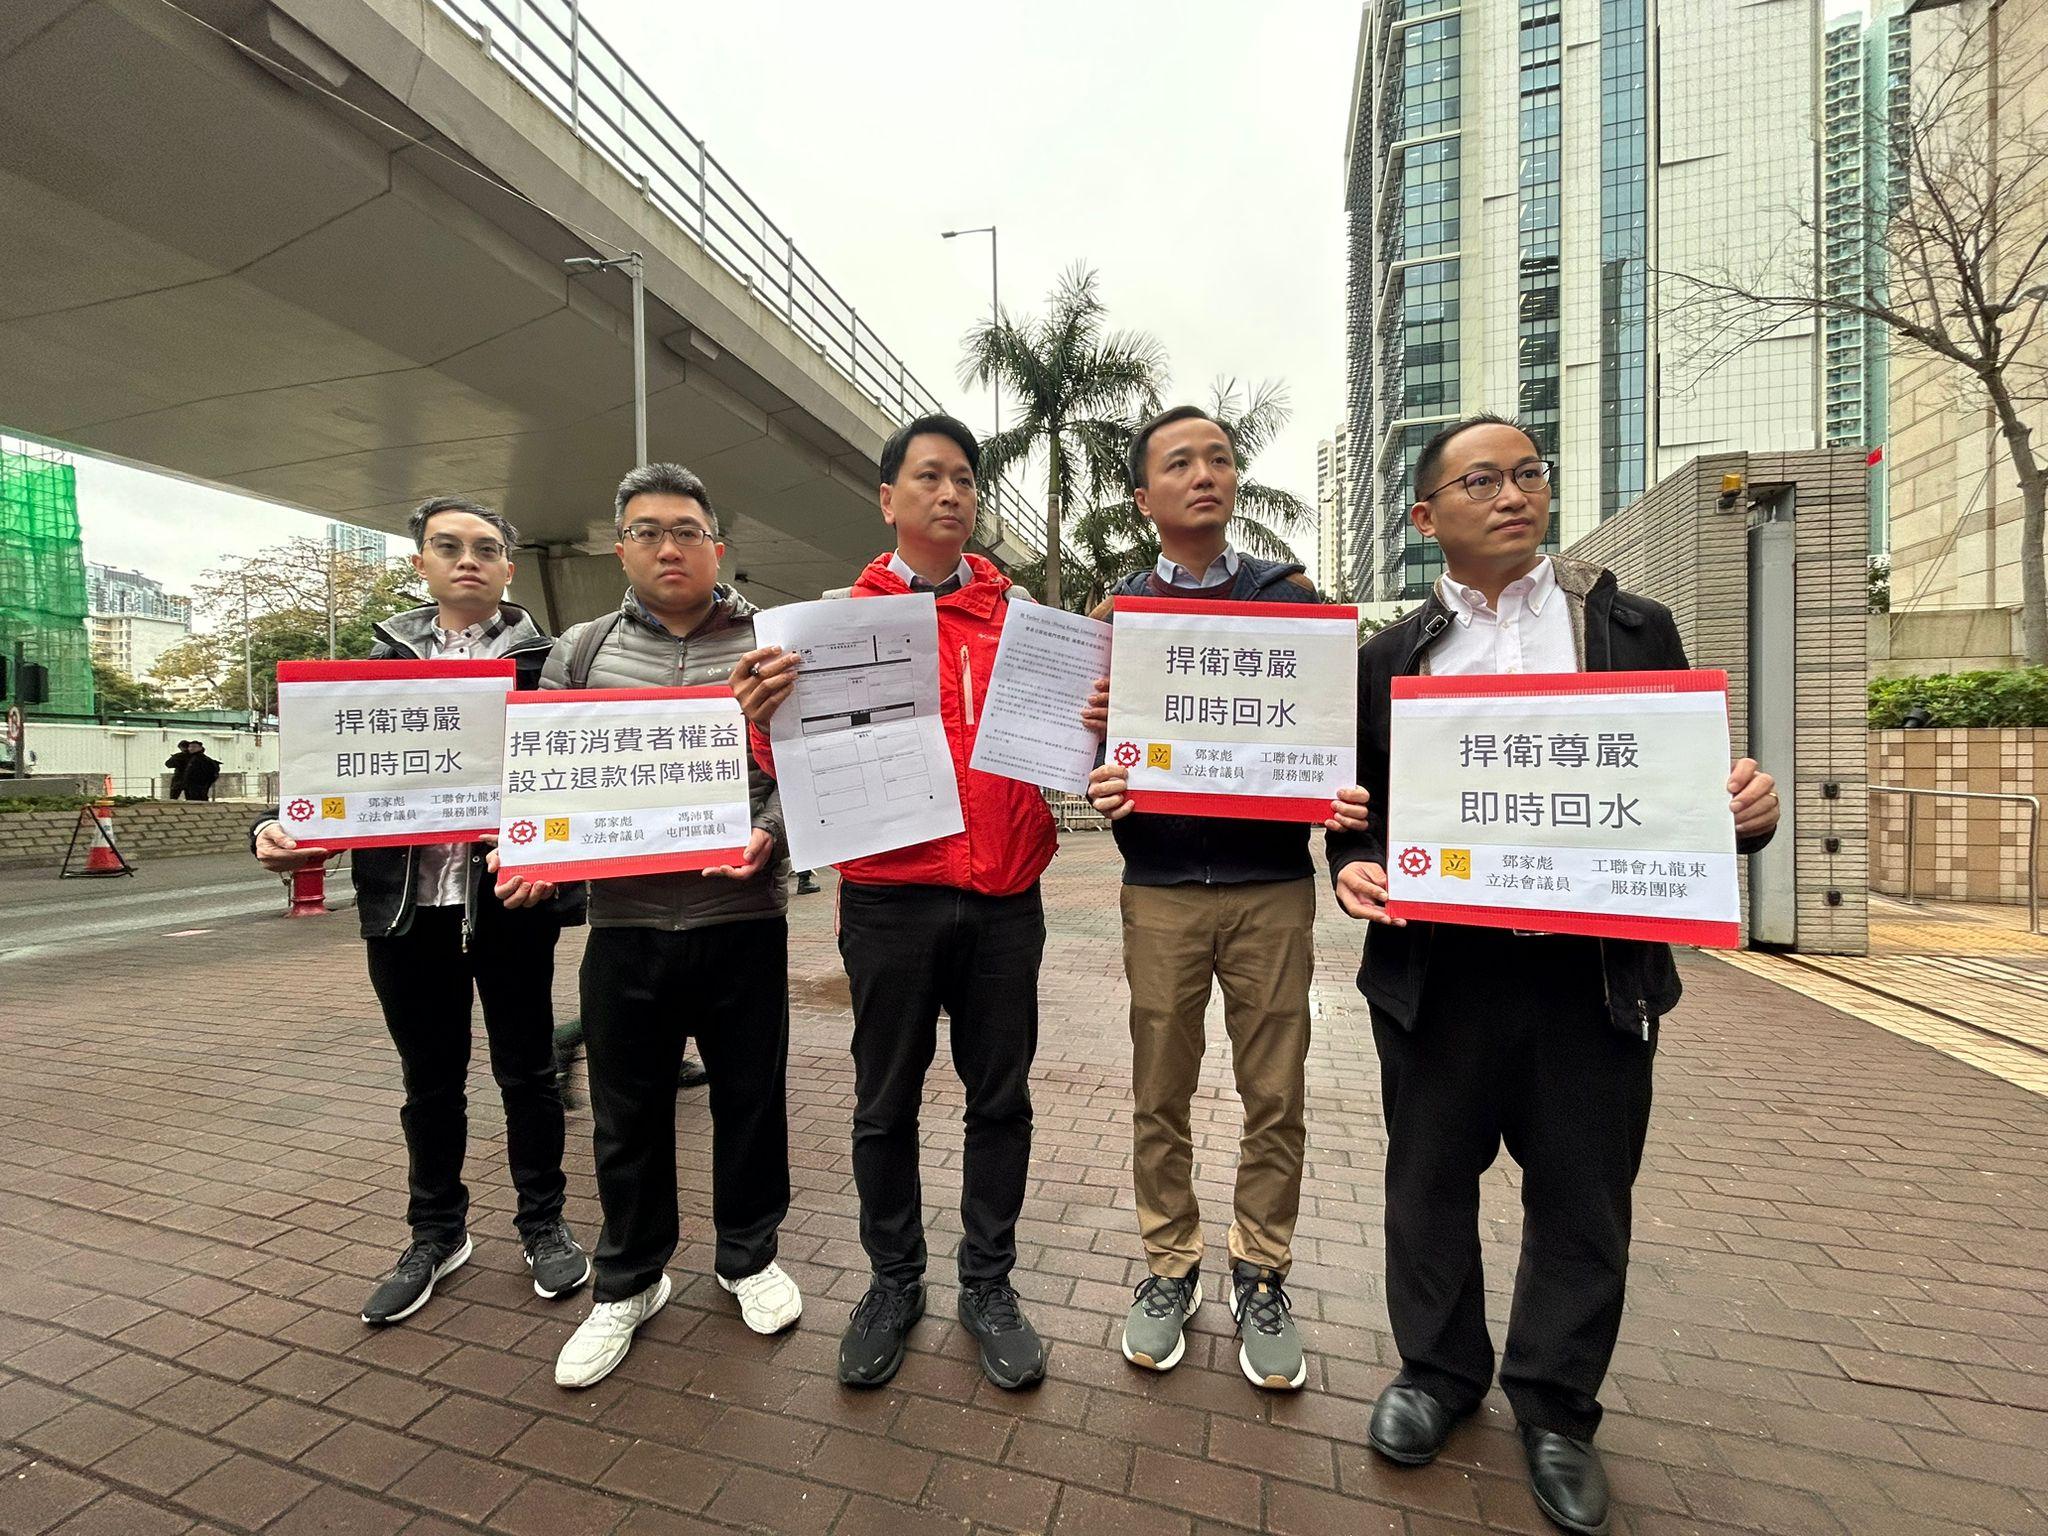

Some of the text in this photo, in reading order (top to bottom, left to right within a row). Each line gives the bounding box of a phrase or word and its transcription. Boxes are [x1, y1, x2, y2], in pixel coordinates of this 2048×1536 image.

[1166, 645, 1297, 679] 捍衛尊嚴
[1164, 694, 1297, 728] 即時回水
[334, 705, 462, 736] 捍衛尊嚴
[510, 722, 739, 758] 捍衛消費者權益
[1195, 748, 1233, 762] 鄧家彪
[1260, 751, 1338, 767] 工聯會九龍東
[1459, 733, 1640, 769] 捍衛尊嚴
[336, 748, 463, 778] 即時回水
[1181, 764, 1245, 779] 立法會議員
[508, 758, 741, 794] 設立退款保障機制
[1272, 768, 1325, 783] 服務團隊
[368, 795, 406, 808] 鄧家彪
[431, 791, 500, 806] 工聯會九龍東
[356, 809, 417, 823] 立法會議員
[441, 805, 489, 818] 服務團隊
[1460, 791, 1643, 829] 即時回水
[594, 815, 633, 828] 鄧家彪
[666, 822, 727, 838] 屯門區議員
[581, 829, 645, 845] 立法會議員
[1502, 854, 1553, 871] 鄧家彪
[1591, 858, 1707, 878] 工聯會九龍東
[1485, 873, 1572, 892] 立法會議員
[1610, 879, 1689, 898] 服務團隊
